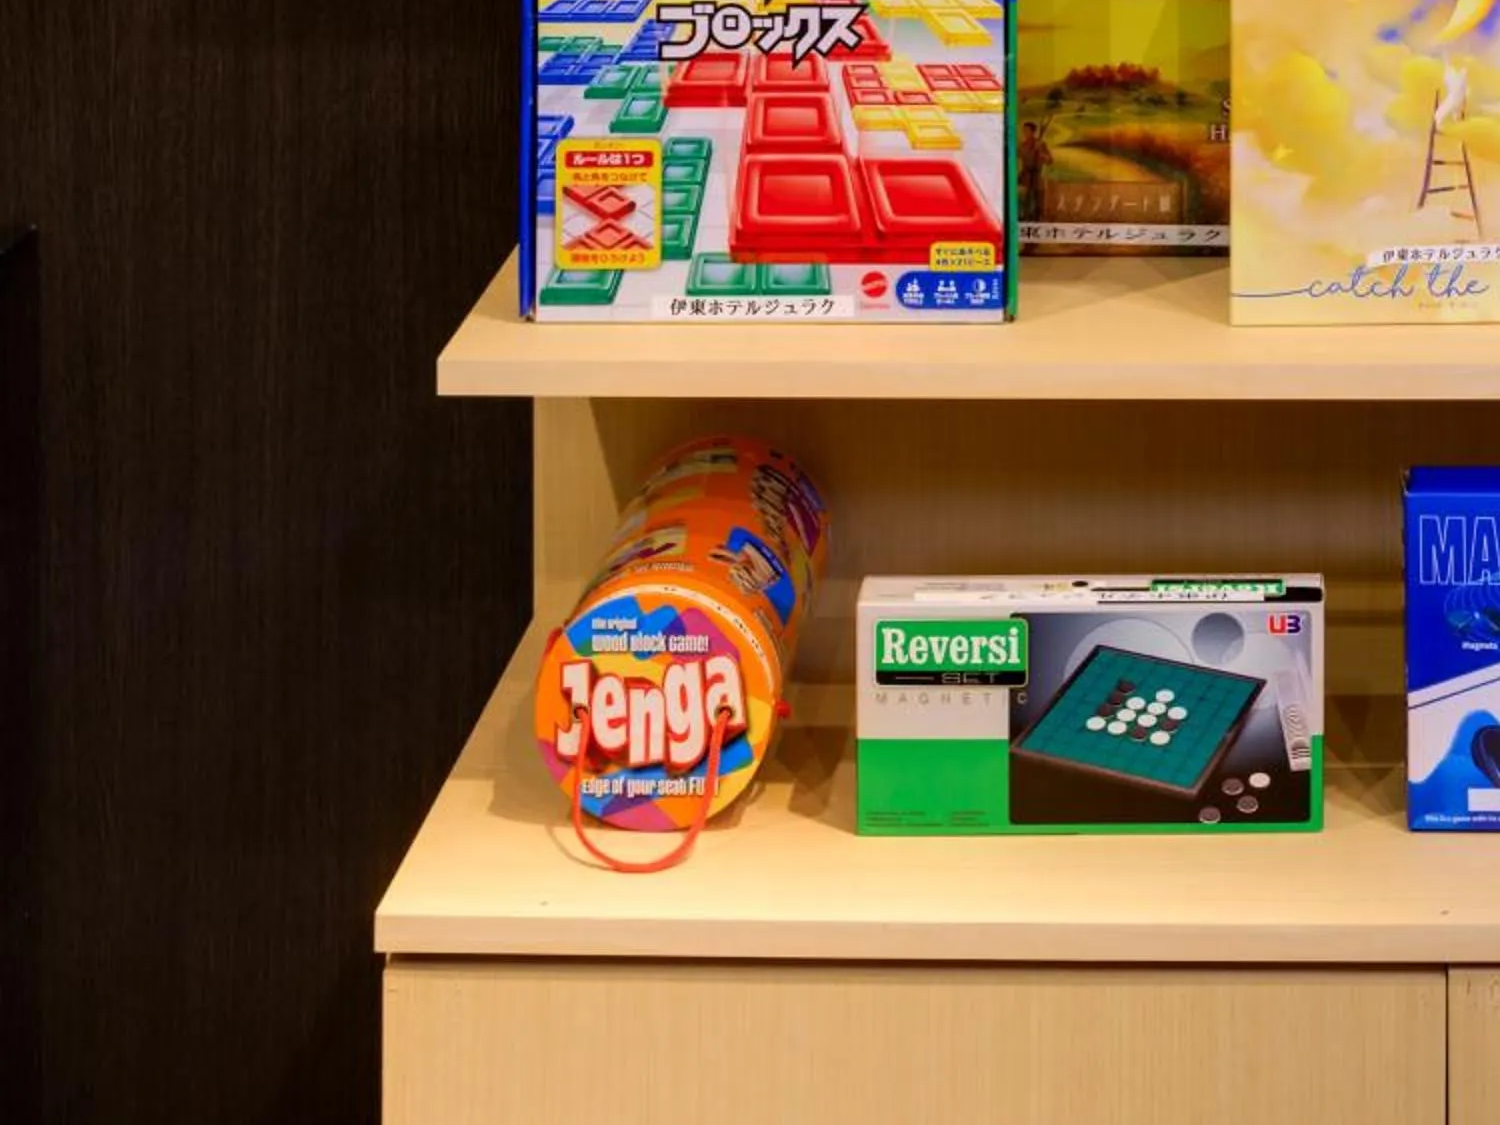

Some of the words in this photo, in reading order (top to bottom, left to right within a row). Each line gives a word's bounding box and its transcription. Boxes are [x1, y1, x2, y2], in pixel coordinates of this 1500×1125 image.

[657, 2, 868, 68] ブロックス
[1020, 226, 1222, 242] 東ホテルジュラク
[1303, 263, 1417, 299] catch
[1427, 262, 1490, 297] the
[670, 298, 836, 316] 伊東ホテルジュラク
[881, 626, 1021, 665] Reversi
[941, 672, 999, 684] SET
[556, 655, 747, 769] Jenga
[627, 777, 656, 797] your
